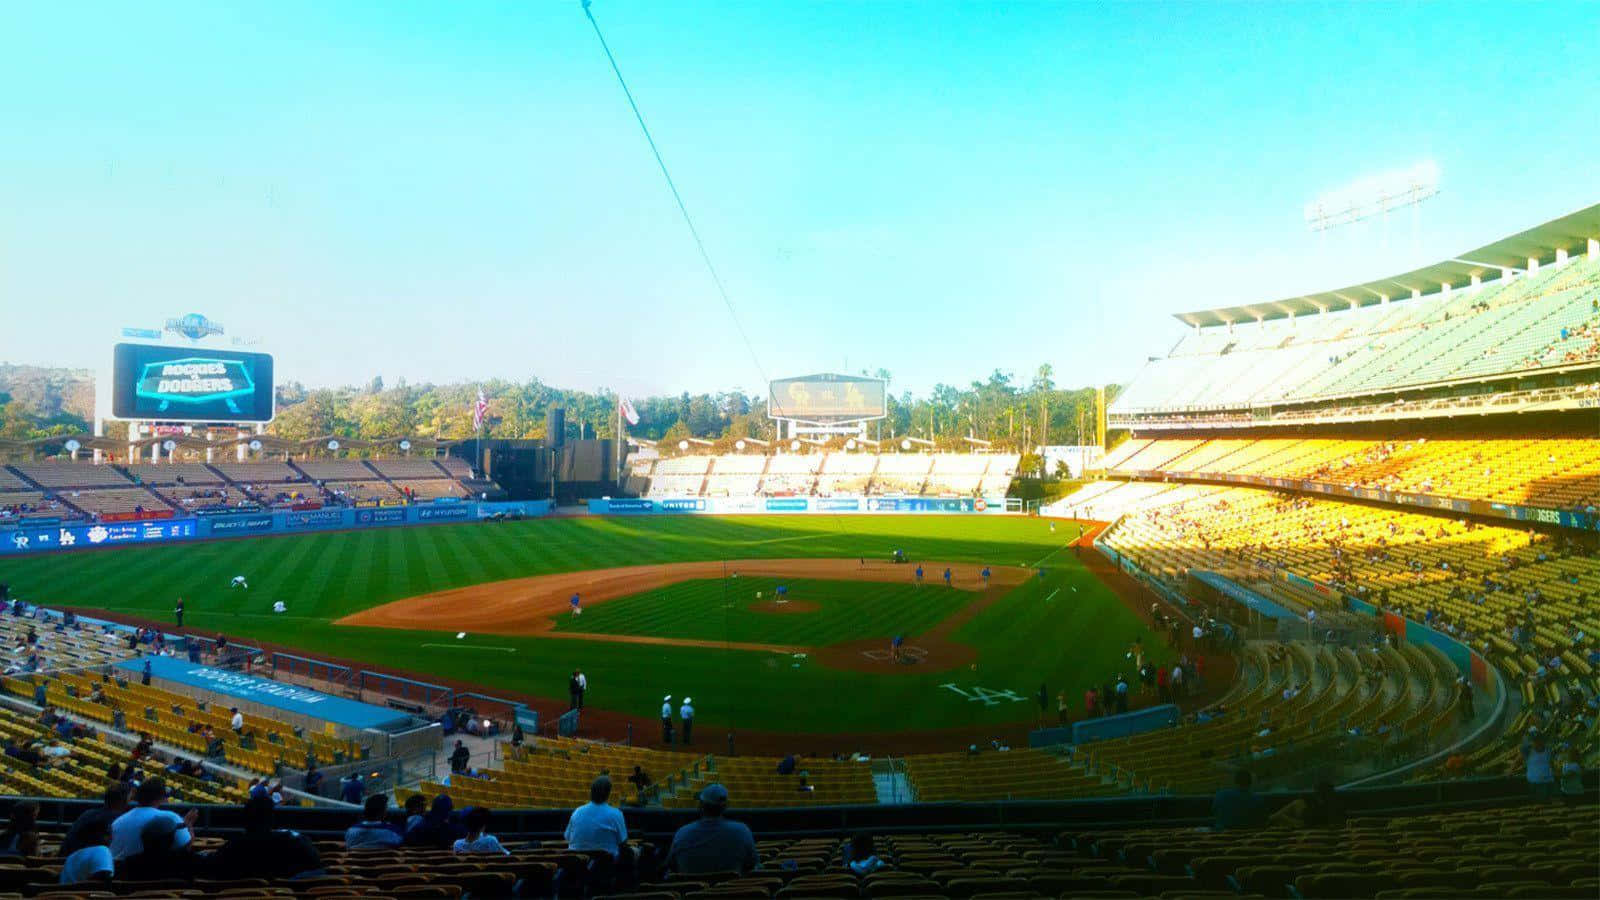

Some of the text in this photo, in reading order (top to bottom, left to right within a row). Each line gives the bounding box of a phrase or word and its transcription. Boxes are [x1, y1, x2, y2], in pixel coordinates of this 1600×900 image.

[162, 363, 226, 375] ROCKIES
[158, 379, 234, 393] DODGERS
[59, 528, 75, 546] LA
[187, 668, 256, 686] DODGER
[248, 682, 328, 703] STADIUM
[937, 683, 1029, 705] LA
